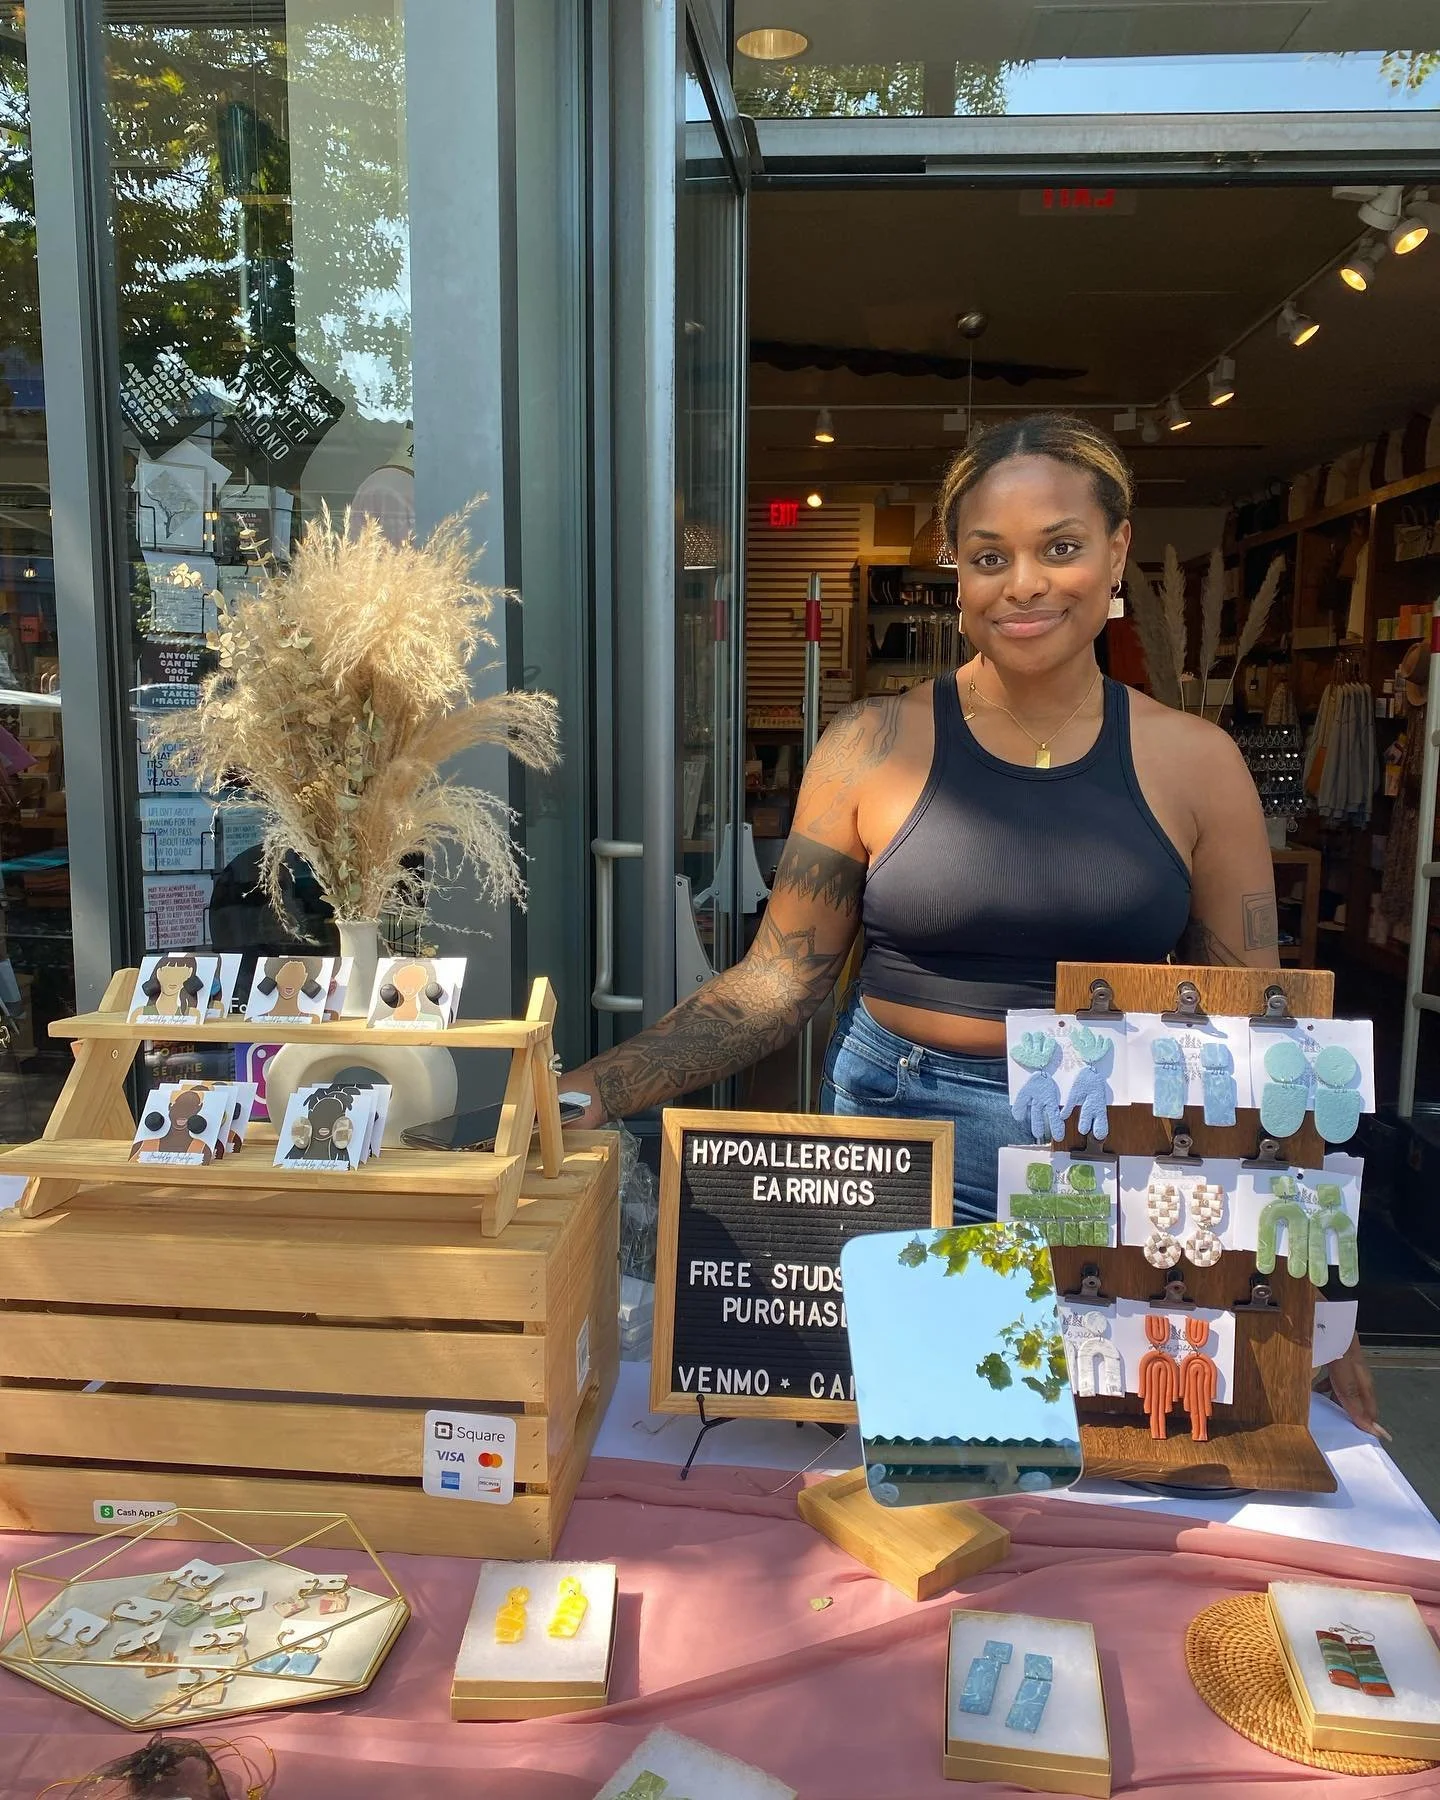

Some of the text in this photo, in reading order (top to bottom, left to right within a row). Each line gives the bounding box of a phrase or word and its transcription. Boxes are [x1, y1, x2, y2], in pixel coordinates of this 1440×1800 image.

[124, 362, 179, 427] AWESOME
[148, 374, 172, 400] BUT
[153, 364, 181, 401] COOL,
[125, 377, 160, 422] TAKES
[770, 503, 798, 528] EXIT
[164, 668, 194, 676] COOL,
[147, 778, 181, 786] YEARS.
[692, 1139, 911, 1173] HYPOALLERGENIC
[753, 1176, 875, 1206] EARRINGS
[689, 1261, 844, 1292] FREE STUDS
[678, 1366, 770, 1396] VENMO
[457, 1426, 505, 1442] Square
[434, 1450, 465, 1462] VISA
[138, 1509, 155, 1518] App
